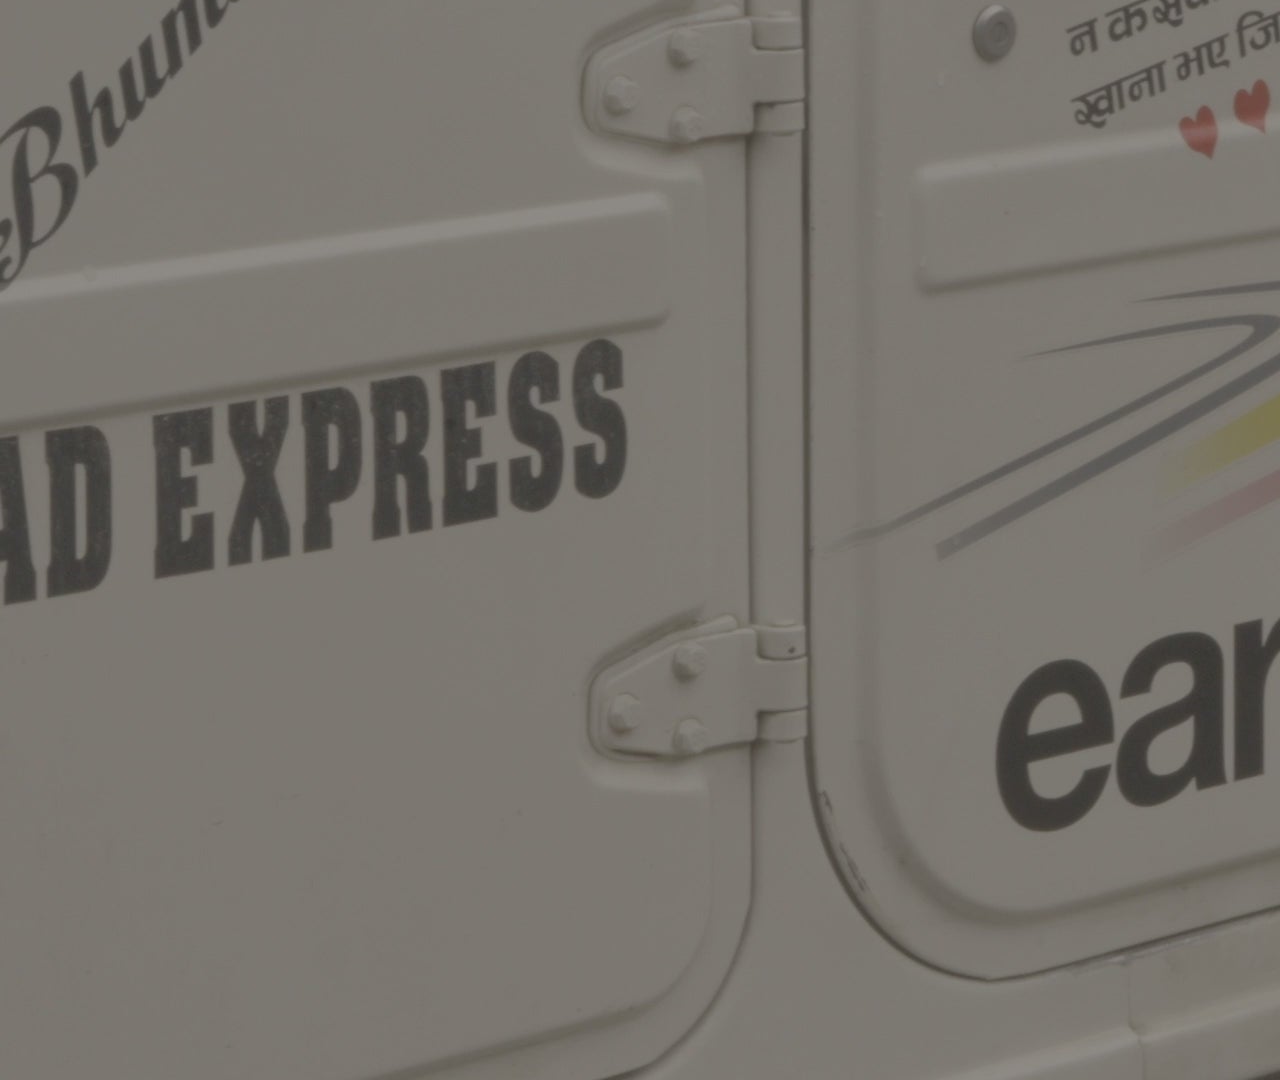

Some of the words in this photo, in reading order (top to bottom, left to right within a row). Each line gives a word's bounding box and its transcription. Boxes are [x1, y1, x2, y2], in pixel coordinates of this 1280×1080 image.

[1067, 18, 1098, 56] न
[1072, 61, 1165, 128] खाना
[1174, 34, 1229, 80] भए
[153, 338, 628, 580] EXPRESS
